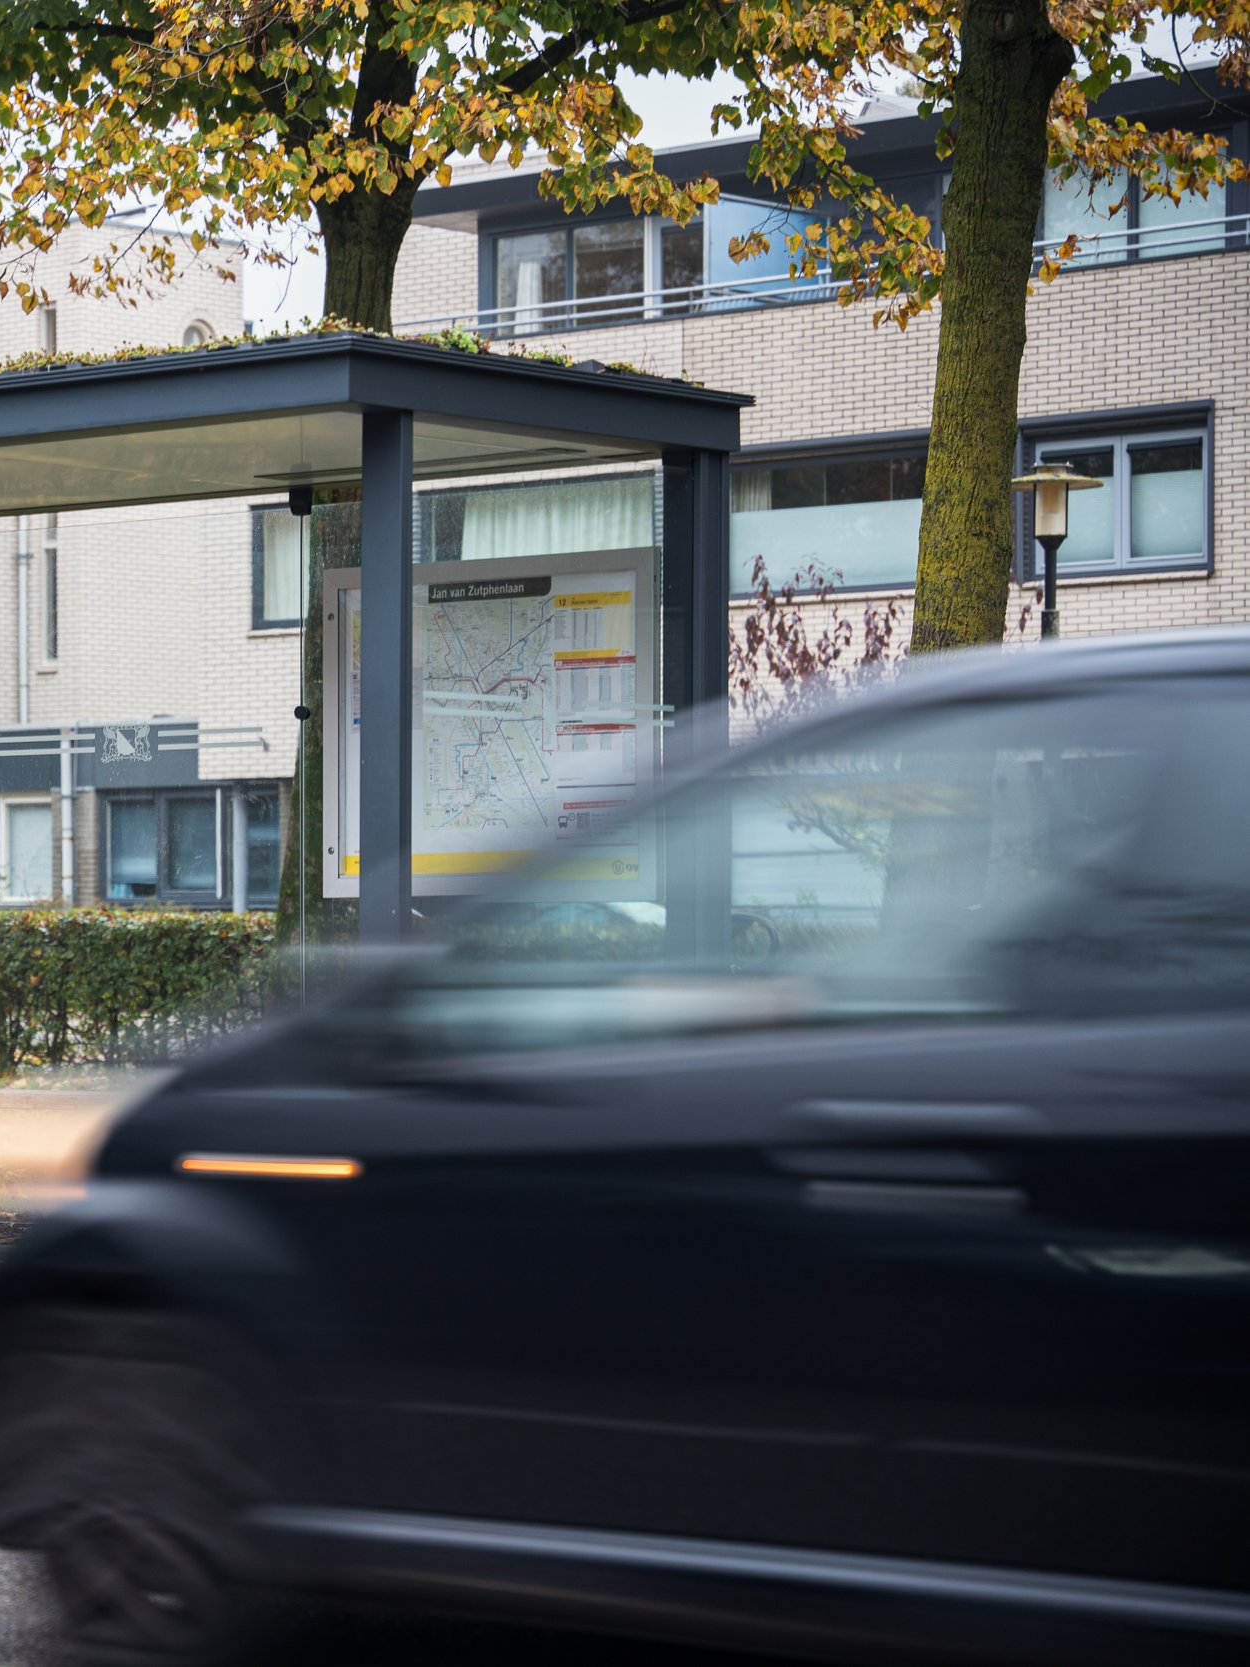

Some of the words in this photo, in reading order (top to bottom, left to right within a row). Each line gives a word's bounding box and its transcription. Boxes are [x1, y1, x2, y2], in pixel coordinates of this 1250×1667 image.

[432, 588, 447, 599] Jan
[450, 589, 465, 597] van
[468, 583, 525, 597] Zutphenlaan
[558, 598, 567, 607] 12
